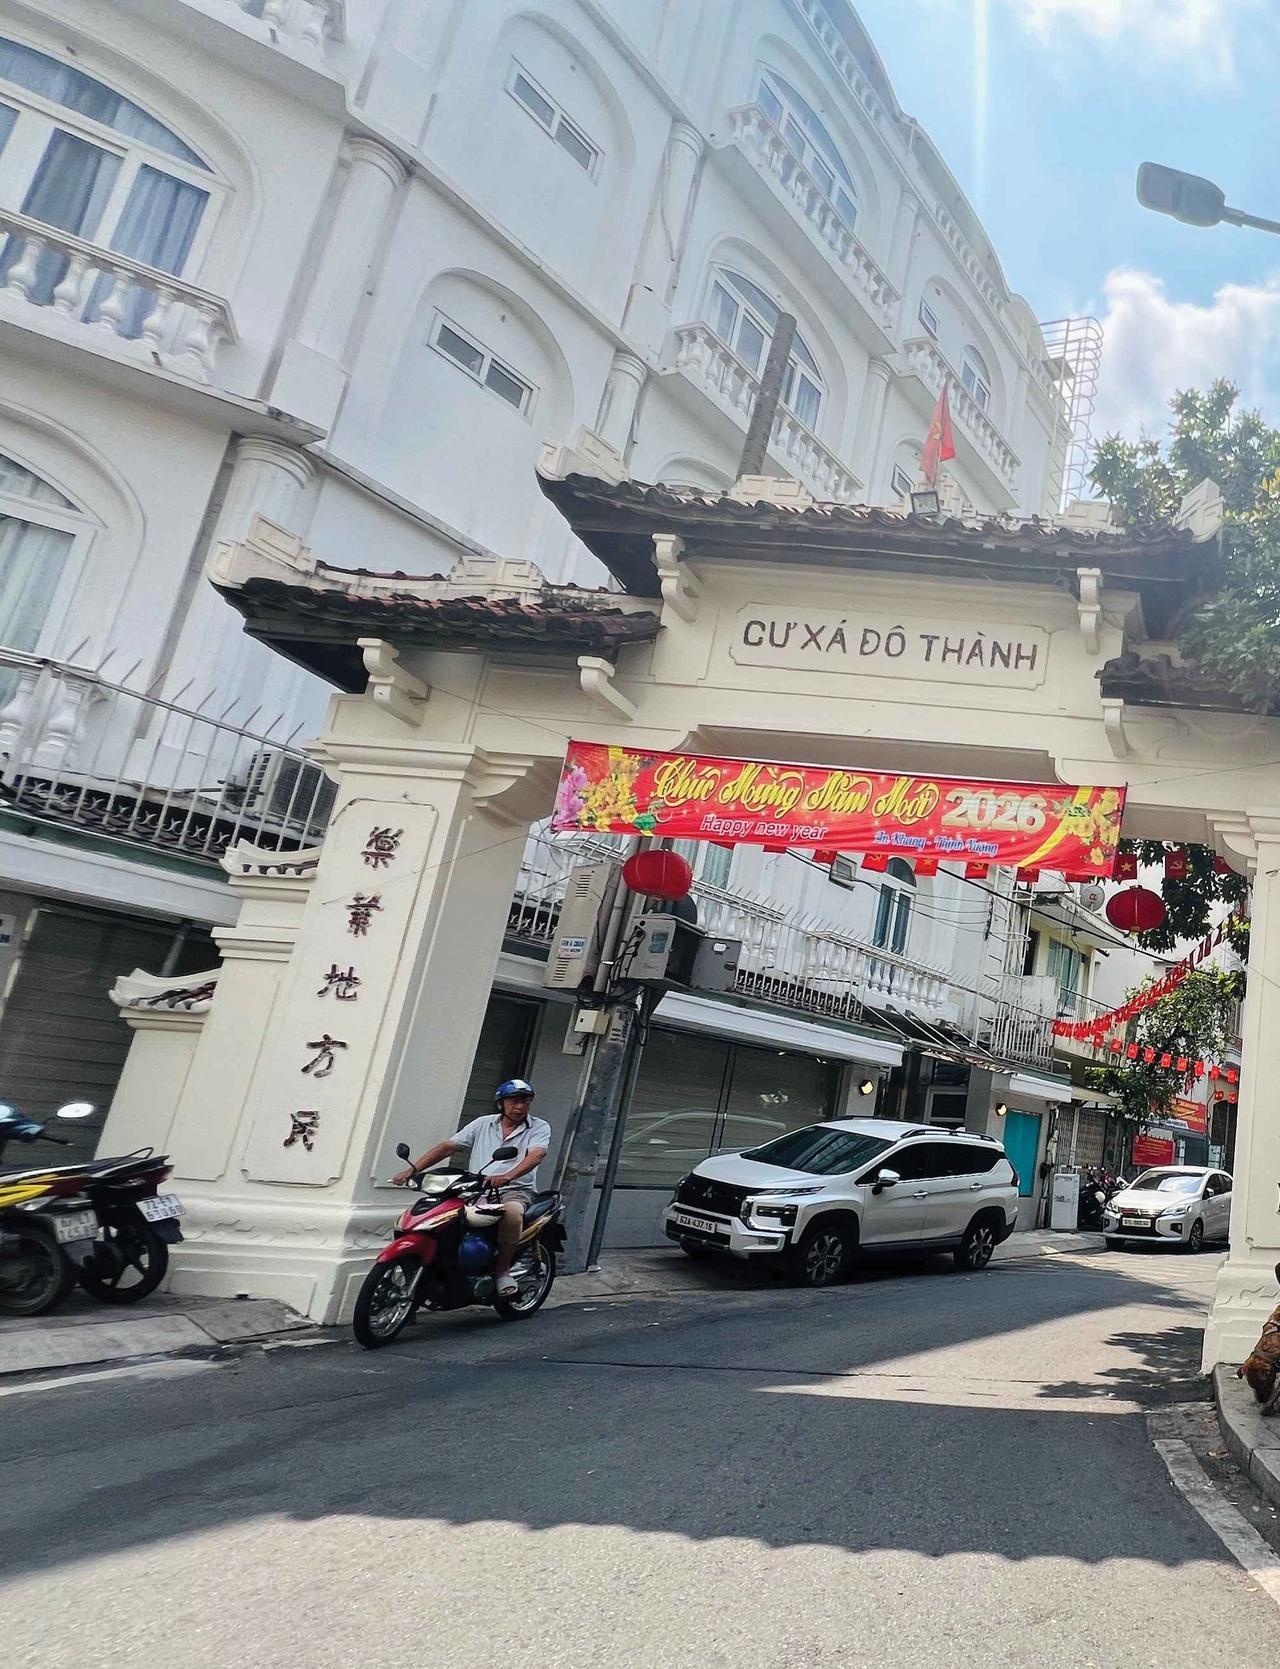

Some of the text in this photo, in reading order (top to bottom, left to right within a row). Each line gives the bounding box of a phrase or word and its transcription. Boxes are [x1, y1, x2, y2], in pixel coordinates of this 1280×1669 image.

[743, 619, 1037, 671] CƯ XÁ ĐÔ THÀNH
[650, 757, 1047, 833] Chúc Mừng Năm Mới 2026
[700, 812, 828, 841] Happy new year
